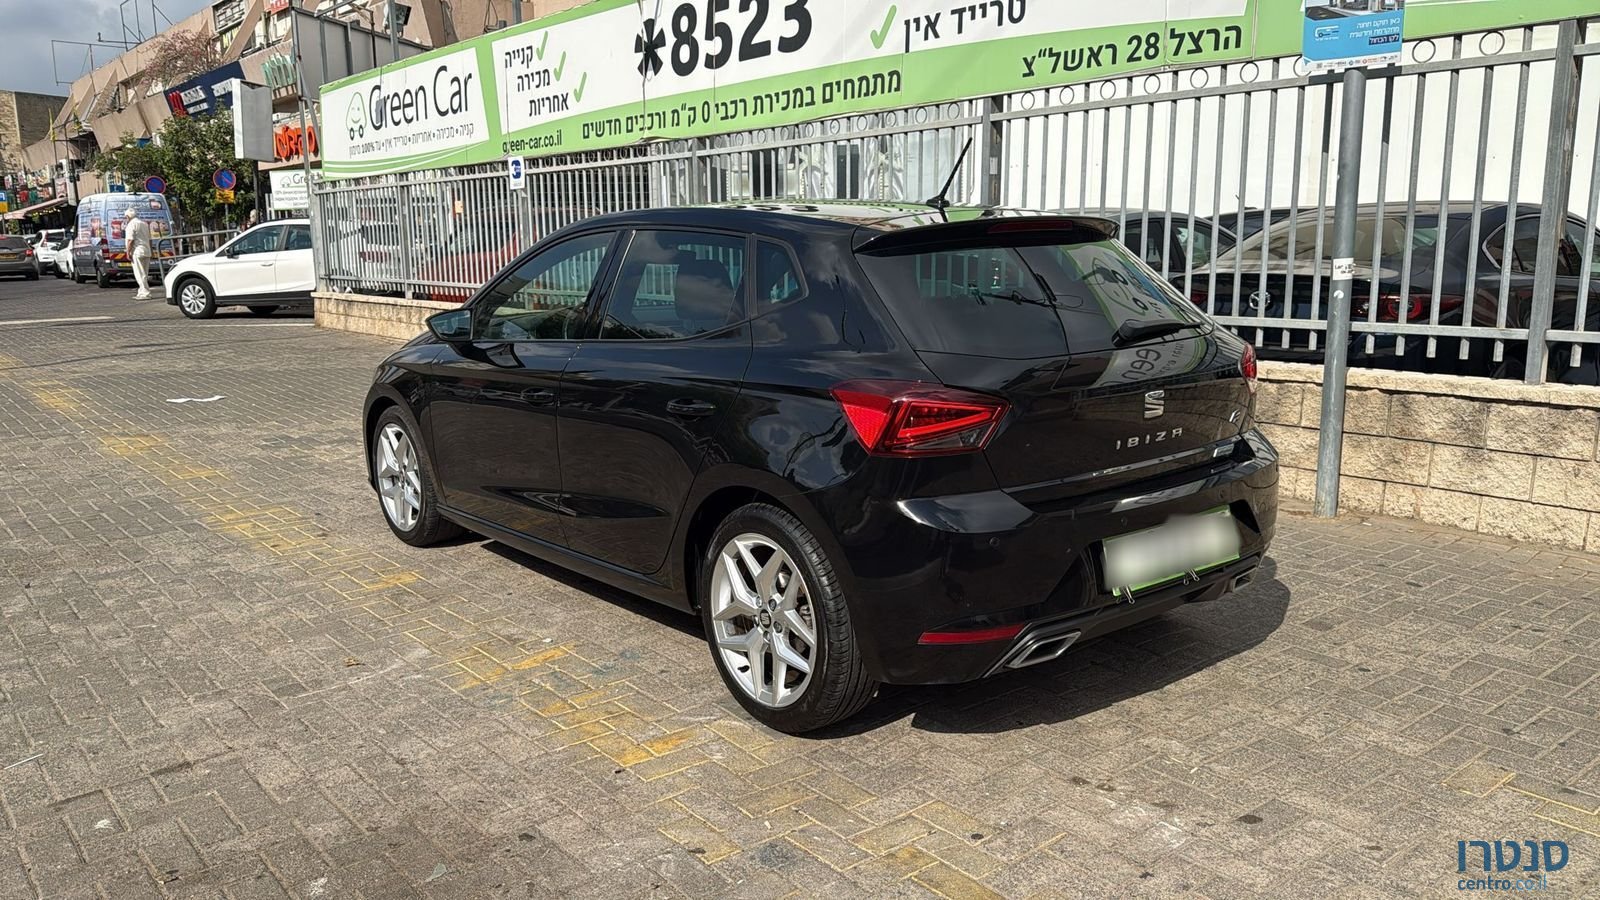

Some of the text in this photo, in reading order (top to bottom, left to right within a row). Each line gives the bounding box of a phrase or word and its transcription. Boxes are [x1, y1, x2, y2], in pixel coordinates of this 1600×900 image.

[904, 0, 1026, 53] טרייד אין
[1126, 32, 1160, 63] 28
[1170, 25, 1243, 57] הרצל
[504, 44, 534, 69] קנייה
[517, 67, 550, 93] מכירה
[823, 68, 901, 105] מתמחים
[369, 65, 473, 131] Green Car
[528, 92, 569, 117] אחריות
[715, 98, 748, 122] רכבי
[752, 85, 816, 116] במכירת
[625, 111, 667, 132] ורכבים
[701, 104, 711, 123] 0
[459, 123, 474, 139] קניה
[582, 116, 622, 140] חדשים
[1115, 427, 1184, 451] IBIZA
